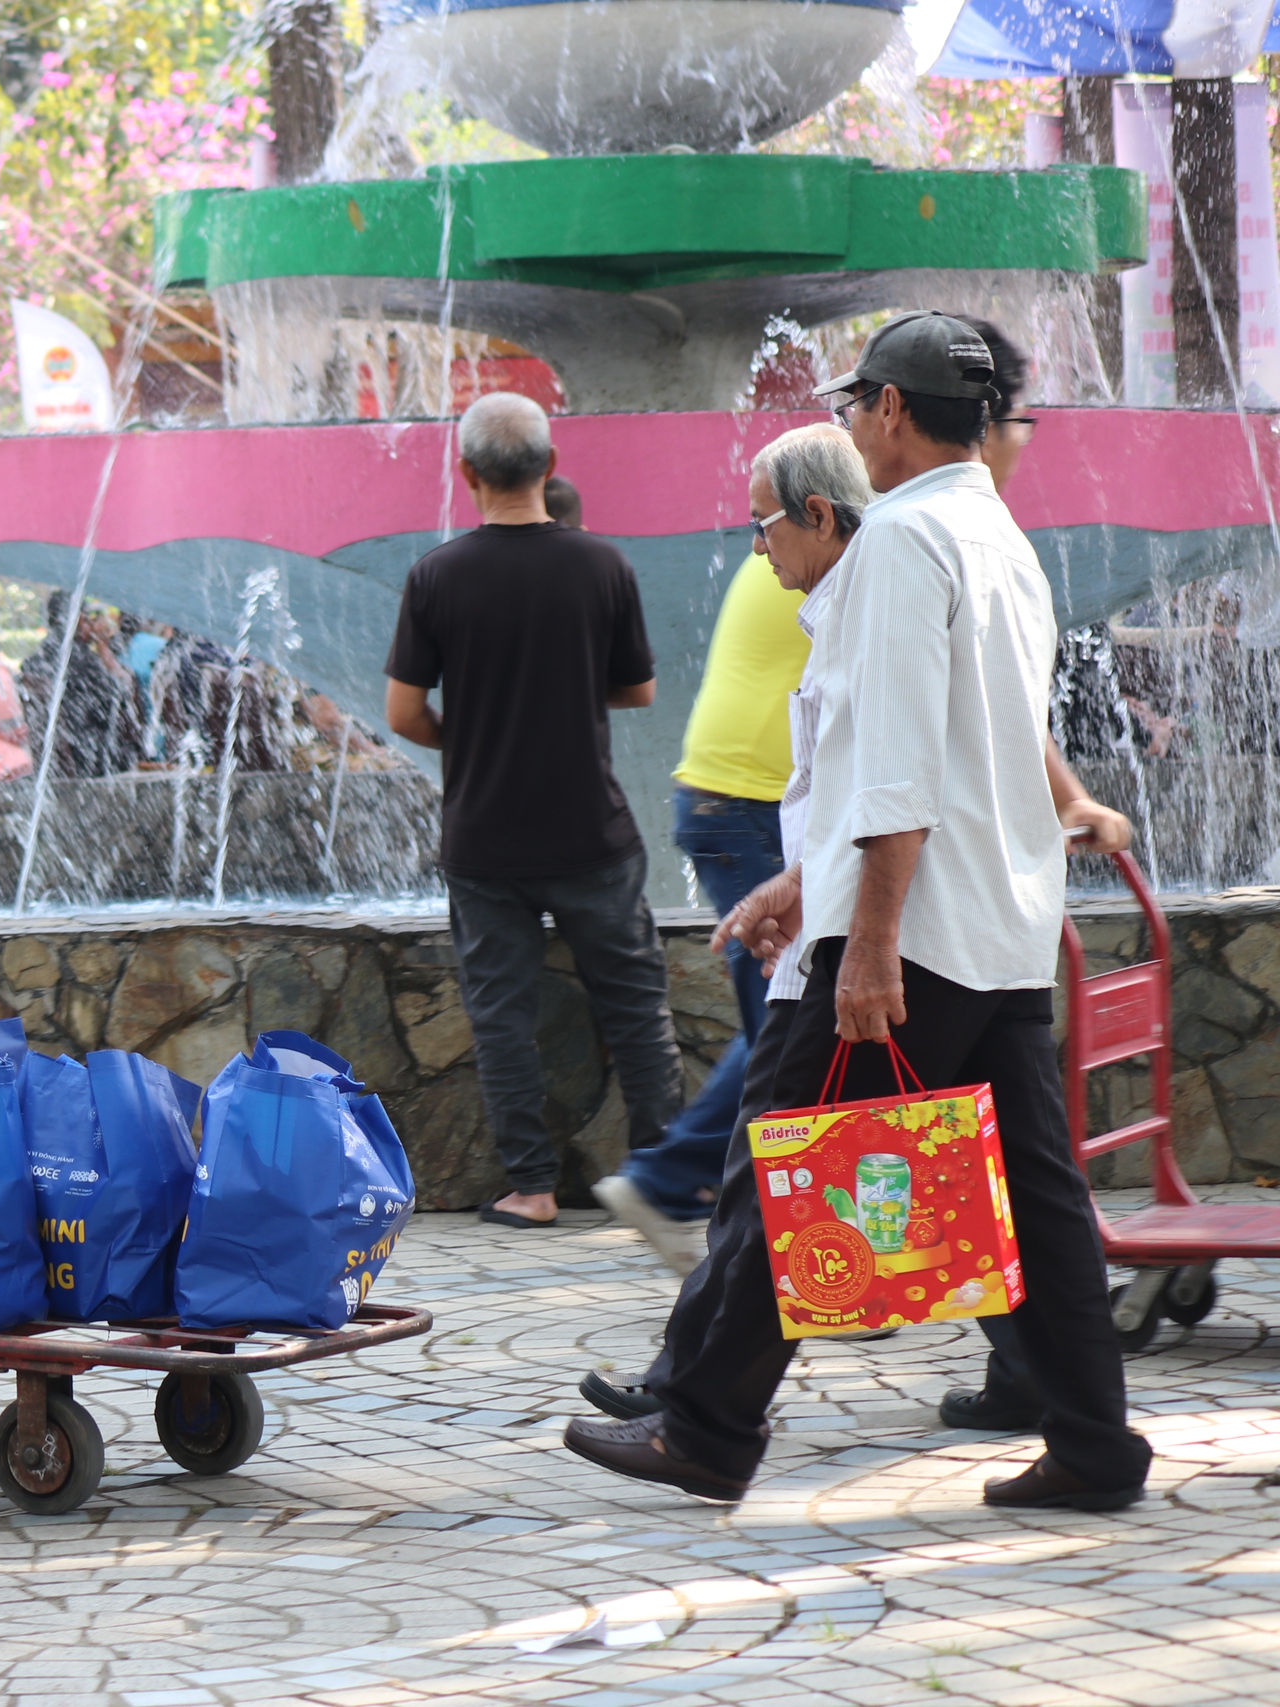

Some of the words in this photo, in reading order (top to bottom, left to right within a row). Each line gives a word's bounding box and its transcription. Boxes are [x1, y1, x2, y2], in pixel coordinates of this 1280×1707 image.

[762, 1124, 810, 1141] Bidrico
[30, 1164, 61, 1180] WEE
[811, 1313, 828, 1324] VẠN
